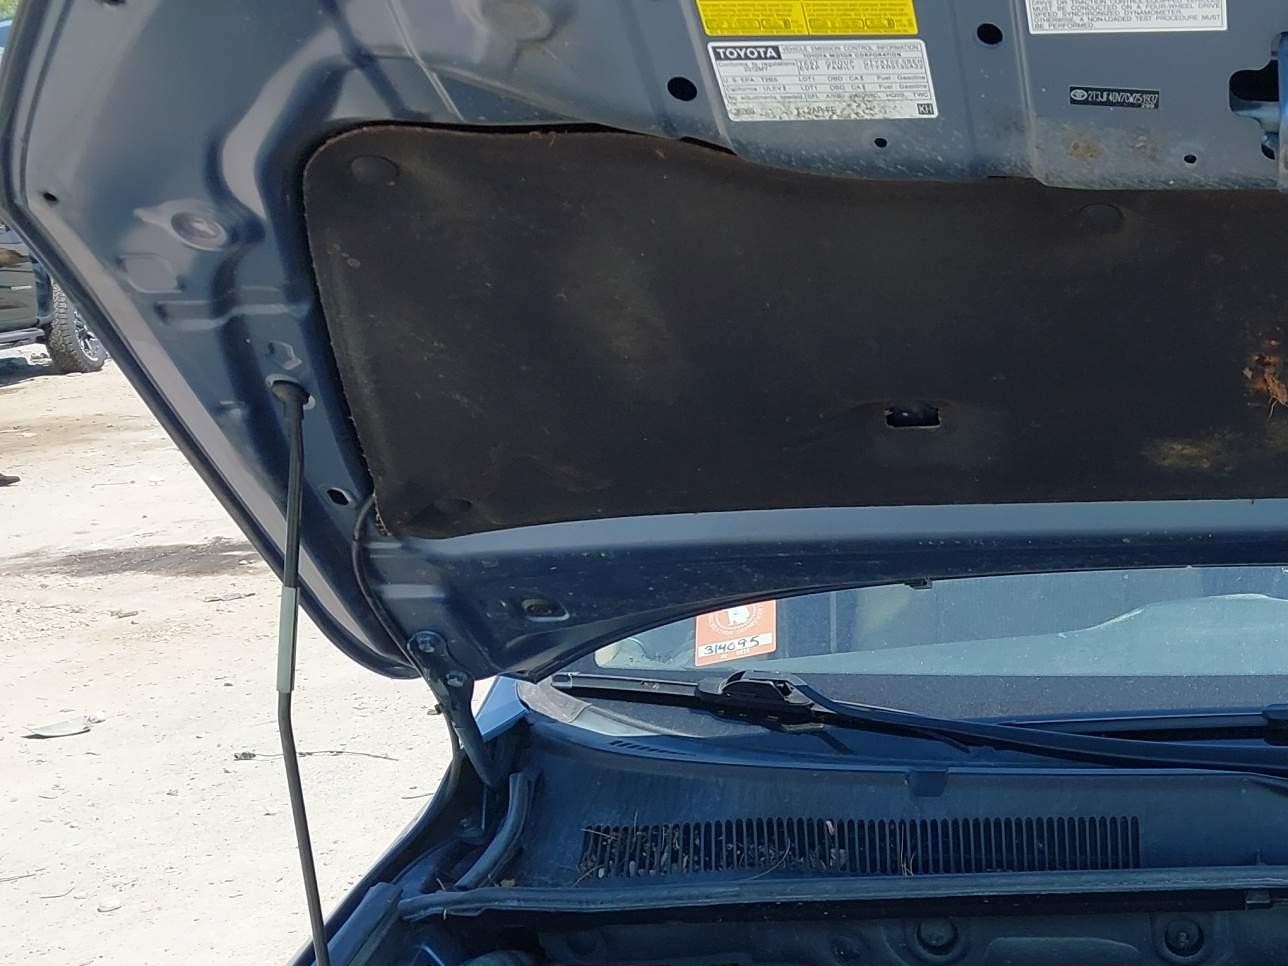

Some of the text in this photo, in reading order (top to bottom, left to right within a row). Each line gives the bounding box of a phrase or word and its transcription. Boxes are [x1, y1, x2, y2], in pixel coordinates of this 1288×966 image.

[715, 47, 779, 59] TOYOTA
[919, 104, 933, 114] KH
[704, 635, 760, 655] 314095
